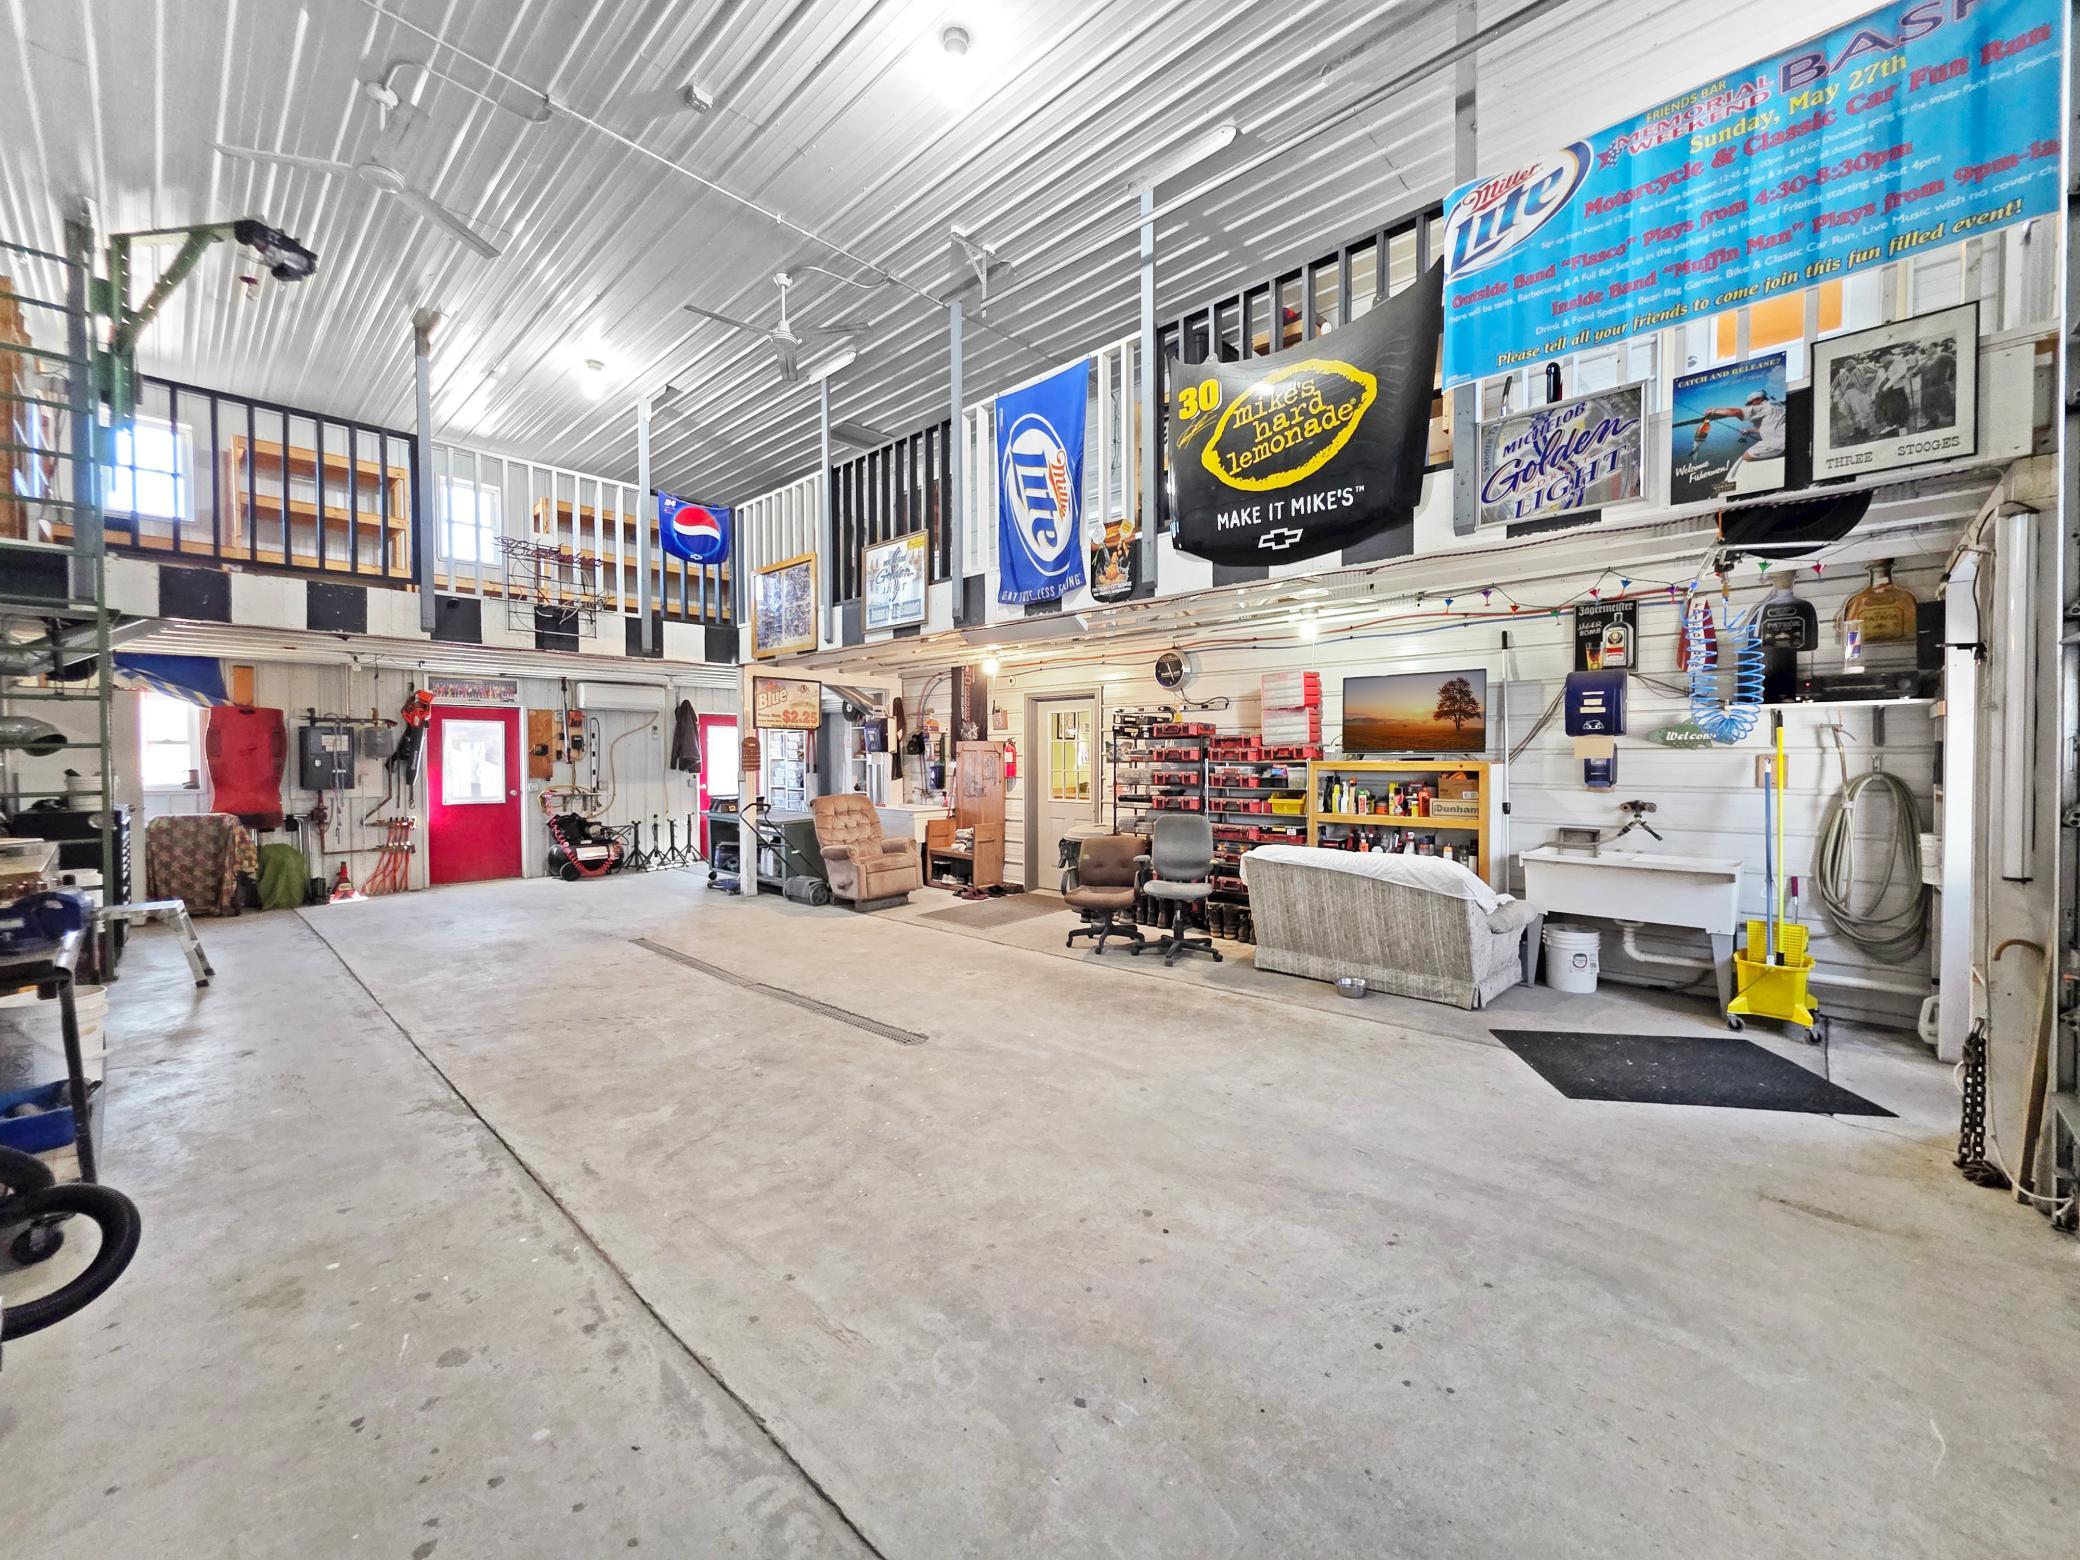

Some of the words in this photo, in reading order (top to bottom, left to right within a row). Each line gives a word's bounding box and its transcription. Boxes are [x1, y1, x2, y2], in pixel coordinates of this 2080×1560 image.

[1584, 160, 1704, 219] Motorcycle
[1711, 146, 1738, 168] &
[1744, 109, 1838, 155] Classic
[1845, 84, 1899, 115] Car
[1909, 57, 1969, 92] Fun
[1980, 24, 2052, 67] Run
[1616, 75, 1774, 149] MEMORIAL
[1629, 90, 1772, 156] WEEKEND
[1646, 92, 1698, 123] FRIENDS
[1701, 80, 1727, 98] BAR
[1689, 109, 1780, 154] Sunday,
[1789, 82, 1840, 115] May
[1848, 54, 1908, 92] 27th
[1463, 163, 1542, 213] Miller
[1452, 280, 1510, 311] Outside
[1513, 263, 1557, 291] Band
[1642, 218, 1695, 247] Plays
[1700, 199, 1749, 231] from
[1754, 142, 1913, 206] 4:30-8:30pm
[1552, 288, 1605, 317] Inside
[1609, 270, 1658, 298] Band
[1812, 202, 1877, 234] Plays
[1882, 179, 1946, 215] from
[1564, 278, 1571, 288] &
[1572, 274, 1580, 285] A
[1581, 268, 1597, 282] Full
[1599, 265, 1615, 277] Bar
[1656, 245, 1672, 257] the
[1674, 233, 1711, 253] parking
[1712, 226, 1726, 238] lot
[1728, 223, 1738, 234] in
[1740, 211, 1765, 229] front
[1768, 207, 1780, 220] of
[1783, 194, 1823, 214] Friends
[1826, 180, 1870, 199] starting
[1873, 166, 1908, 184] about
[1912, 155, 1942, 170] 4pm
[1535, 321, 1560, 336] Drink
[1562, 318, 1569, 328] &
[1572, 312, 1595, 326] Food
[1637, 292, 1662, 306] Bean
[1664, 286, 1683, 297] Bag
[1725, 265, 1750, 279] Bike
[1752, 261, 1761, 271] &
[1765, 249, 1803, 266] Classic
[1806, 240, 1828, 253] Car
[1862, 220, 1889, 236] Live
[1892, 206, 1931, 226] Music
[1934, 195, 1966, 212] with
[1969, 187, 1988, 200] no
[1992, 171, 2037, 193] cover
[1496, 345, 1540, 368] Please
[1543, 334, 1567, 354] tell
[1570, 328, 1590, 347] all
[1594, 321, 1629, 343] your
[1633, 303, 1688, 331] friends
[1693, 297, 1709, 312] to
[1715, 282, 1760, 306] come
[1764, 270, 1799, 295] join
[1804, 257, 1841, 279] this
[1847, 246, 1882, 270] fun
[1888, 220, 1947, 258] filled
[1952, 197, 2024, 234] event!
[1177, 378, 1223, 421] 30
[1232, 378, 1316, 429] mike's
[1678, 375, 1708, 389] CATCH
[1710, 369, 1730, 382] AND
[1253, 390, 1327, 443] hard
[1502, 401, 1587, 458] MICHELOB
[1481, 417, 1639, 503] Golden
[1825, 452, 1874, 470] THREE
[1897, 435, 1961, 457] STOOGES
[1515, 443, 1628, 519] LIGHT
[1217, 505, 1262, 531] MAKE
[1268, 500, 1286, 521] IT
[758, 689, 788, 710] Blue
[783, 709, 818, 724] $2.25
